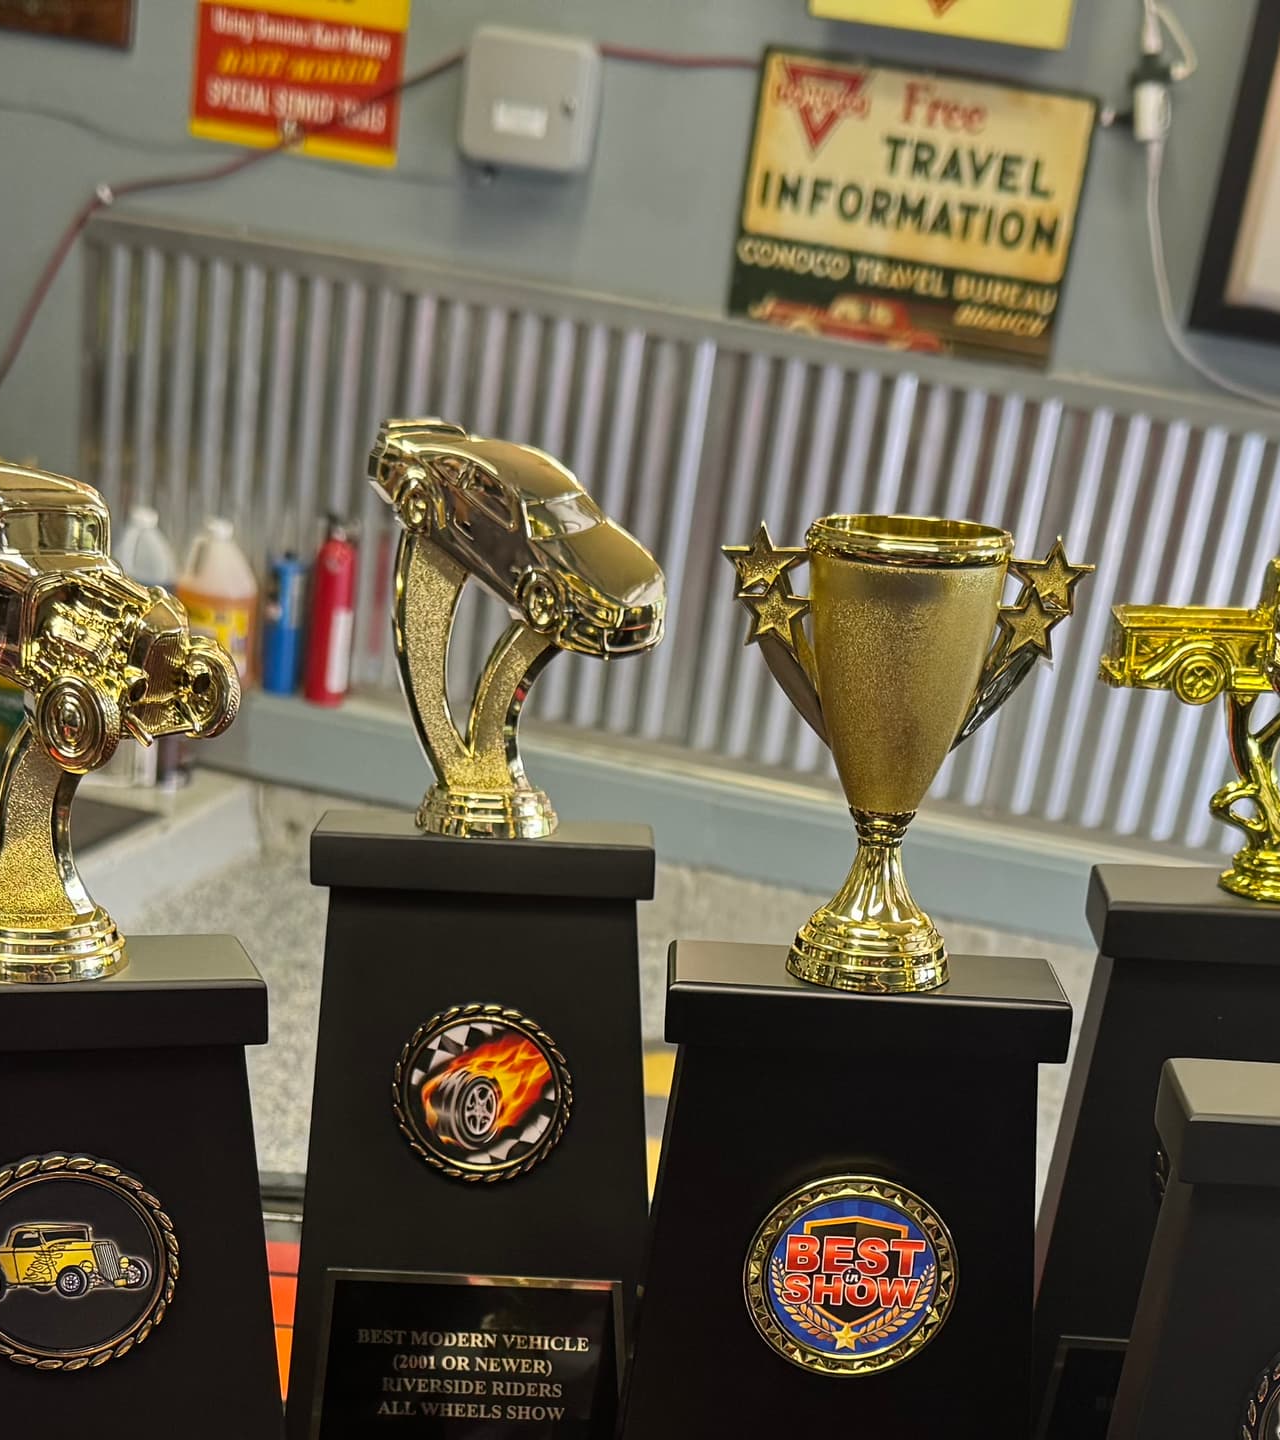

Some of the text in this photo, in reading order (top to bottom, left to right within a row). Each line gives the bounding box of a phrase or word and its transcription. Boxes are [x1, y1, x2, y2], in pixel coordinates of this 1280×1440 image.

[207, 75, 271, 115] SPECIAL
[902, 80, 987, 136] Free
[885, 135, 1054, 199] TRAVEL
[760, 170, 1059, 255] INFORMATION
[737, 238, 1058, 315] CONOCO TRAVEL BUREAU
[784, 1234, 926, 1277] BEST
[781, 1272, 920, 1308] SHOW
[845, 1270, 859, 1282] in
[357, 1328, 589, 1352] BEST MODERN VEHICLE
[393, 1354, 552, 1376] (2001 OR NEWER)
[381, 1377, 562, 1398] RIVERSIDE RIDERS
[377, 1401, 564, 1421] ALL WHEELS SHOW
